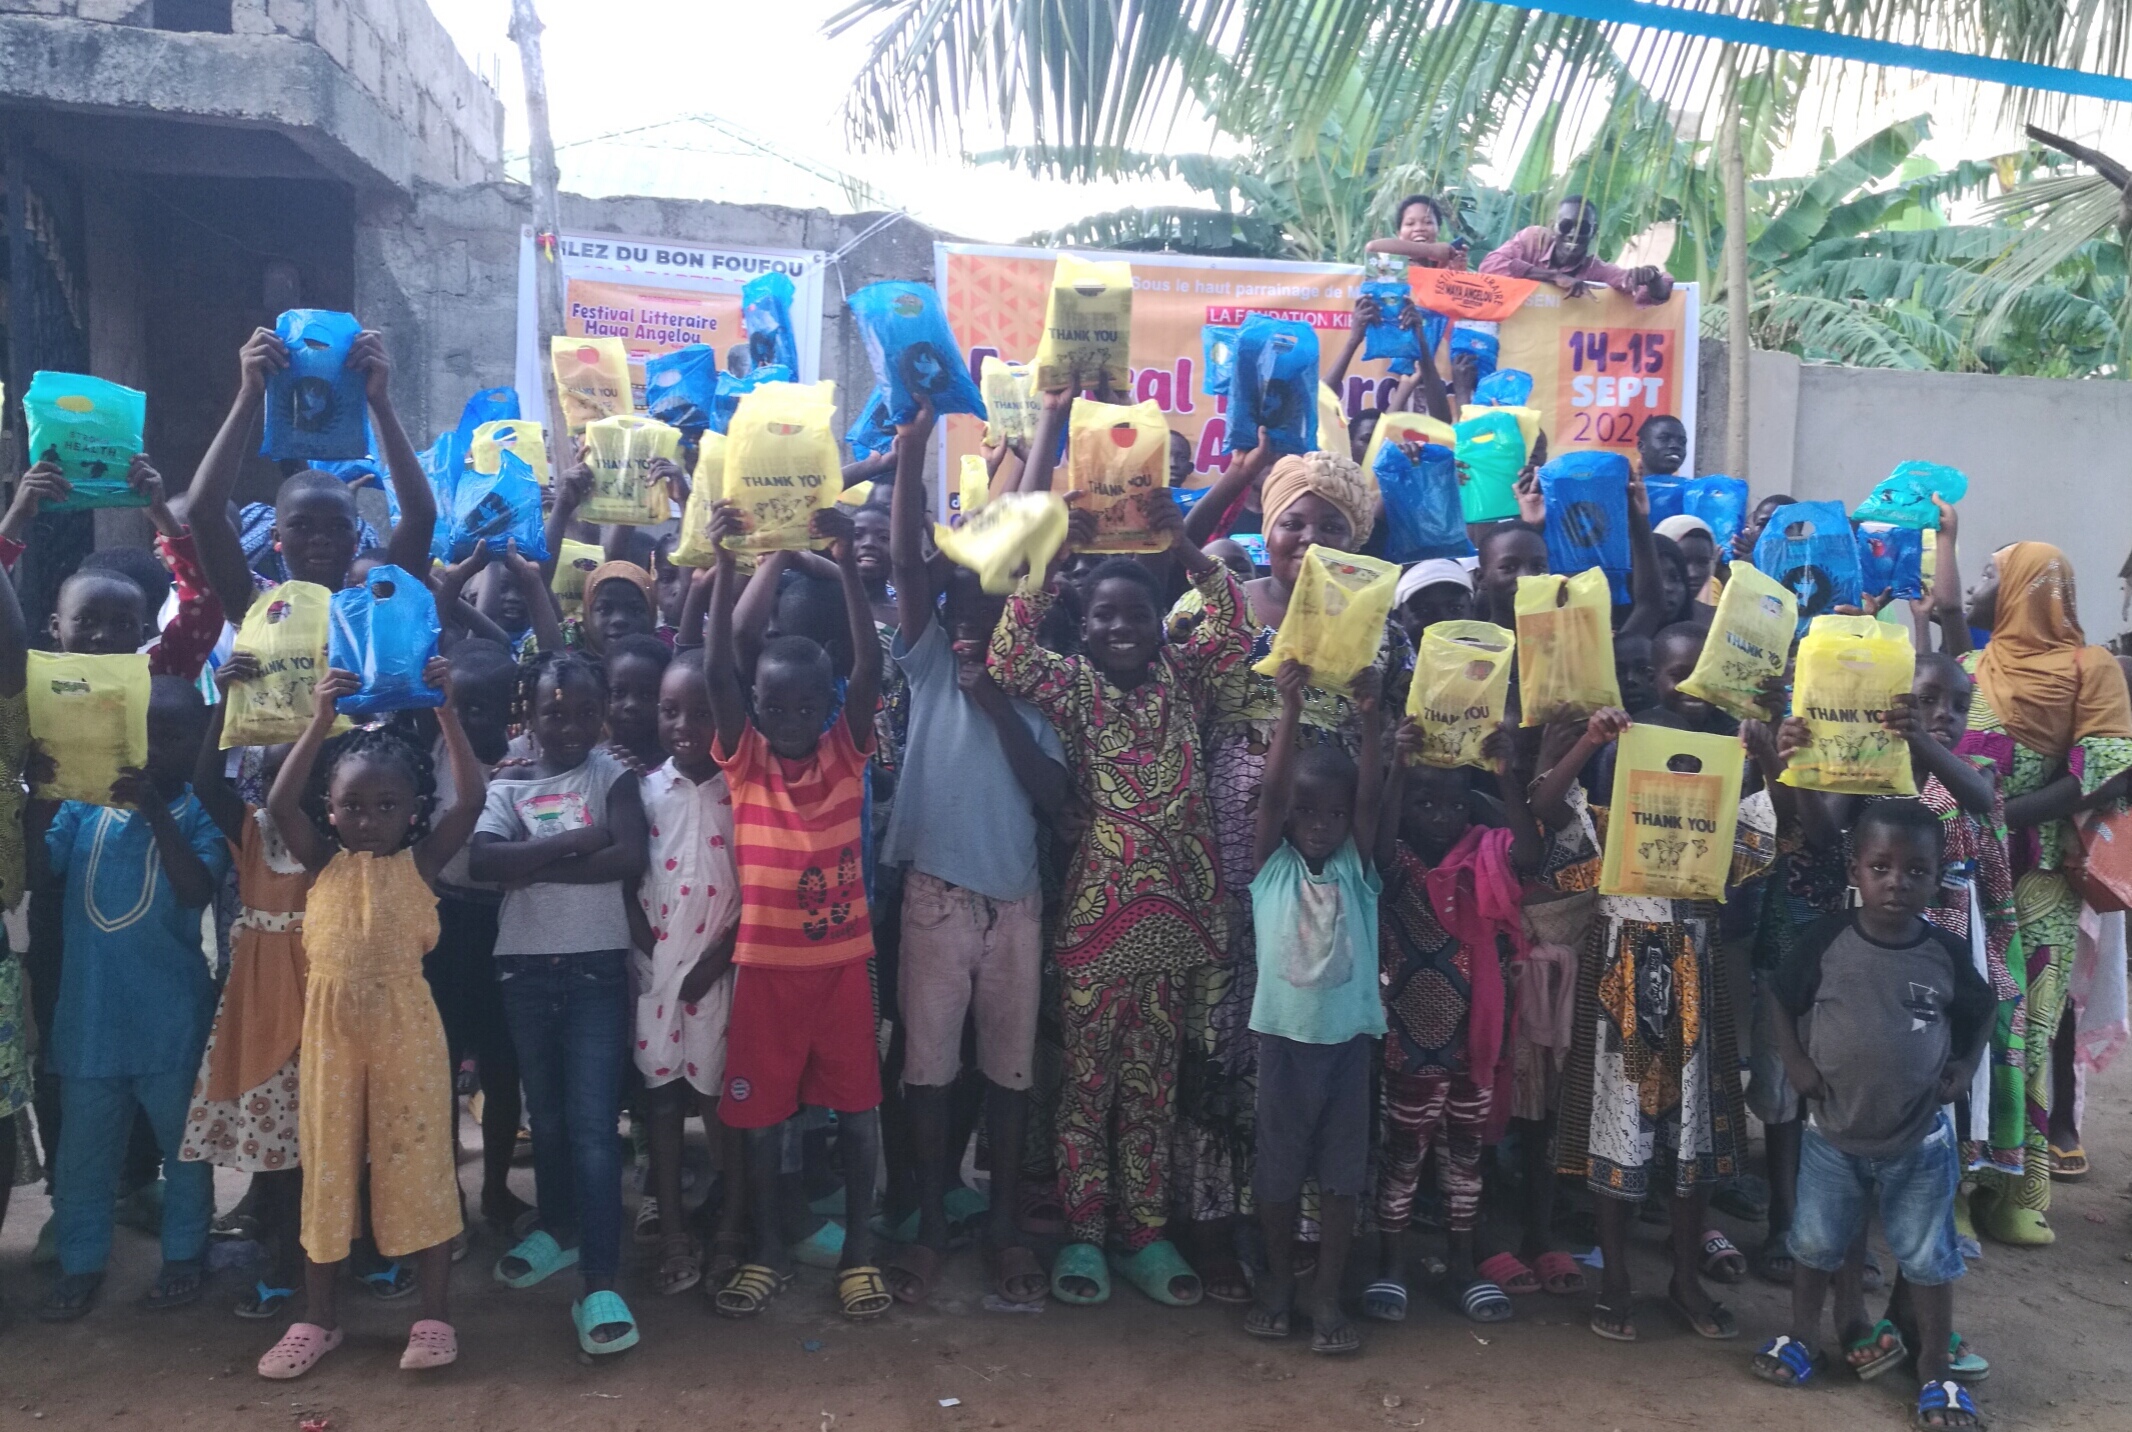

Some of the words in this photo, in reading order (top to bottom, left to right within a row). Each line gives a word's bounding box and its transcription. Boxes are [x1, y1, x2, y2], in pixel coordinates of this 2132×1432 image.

[560, 240, 609, 260] ILEZ
[616, 246, 648, 263] DU
[656, 250, 704, 269] BON
[712, 254, 803, 277] FOUFOU
[1131, 276, 1171, 292] Sous
[1176, 278, 1190, 293] le
[1195, 280, 1231, 295] haut
[1235, 284, 1319, 300] parrainage
[1325, 286, 1343, 298] de
[572, 303, 635, 323] Festival
[1209, 308, 1231, 323] LA
[585, 320, 629, 337] Maya
[635, 324, 702, 346] Angelou
[1048, 328, 1090, 342] THANK
[1094, 330, 1118, 343] YOU
[1568, 330, 1665, 374] 14-15
[1571, 375, 1665, 409] SEPT
[1573, 412, 1635, 443] 202
[64, 441, 118, 457] HEALTH
[634, 459, 651, 470] YO
[741, 475, 795, 487] THANK
[1088, 480, 1126, 497] THANK
[1725, 630, 1764, 659] THANK
[1424, 707, 1460, 726] THAN
[1806, 707, 1860, 723] THANK
[1863, 709, 1883, 724] YO
[1632, 811, 1684, 830] THANK
[1687, 817, 1717, 834] YOU
